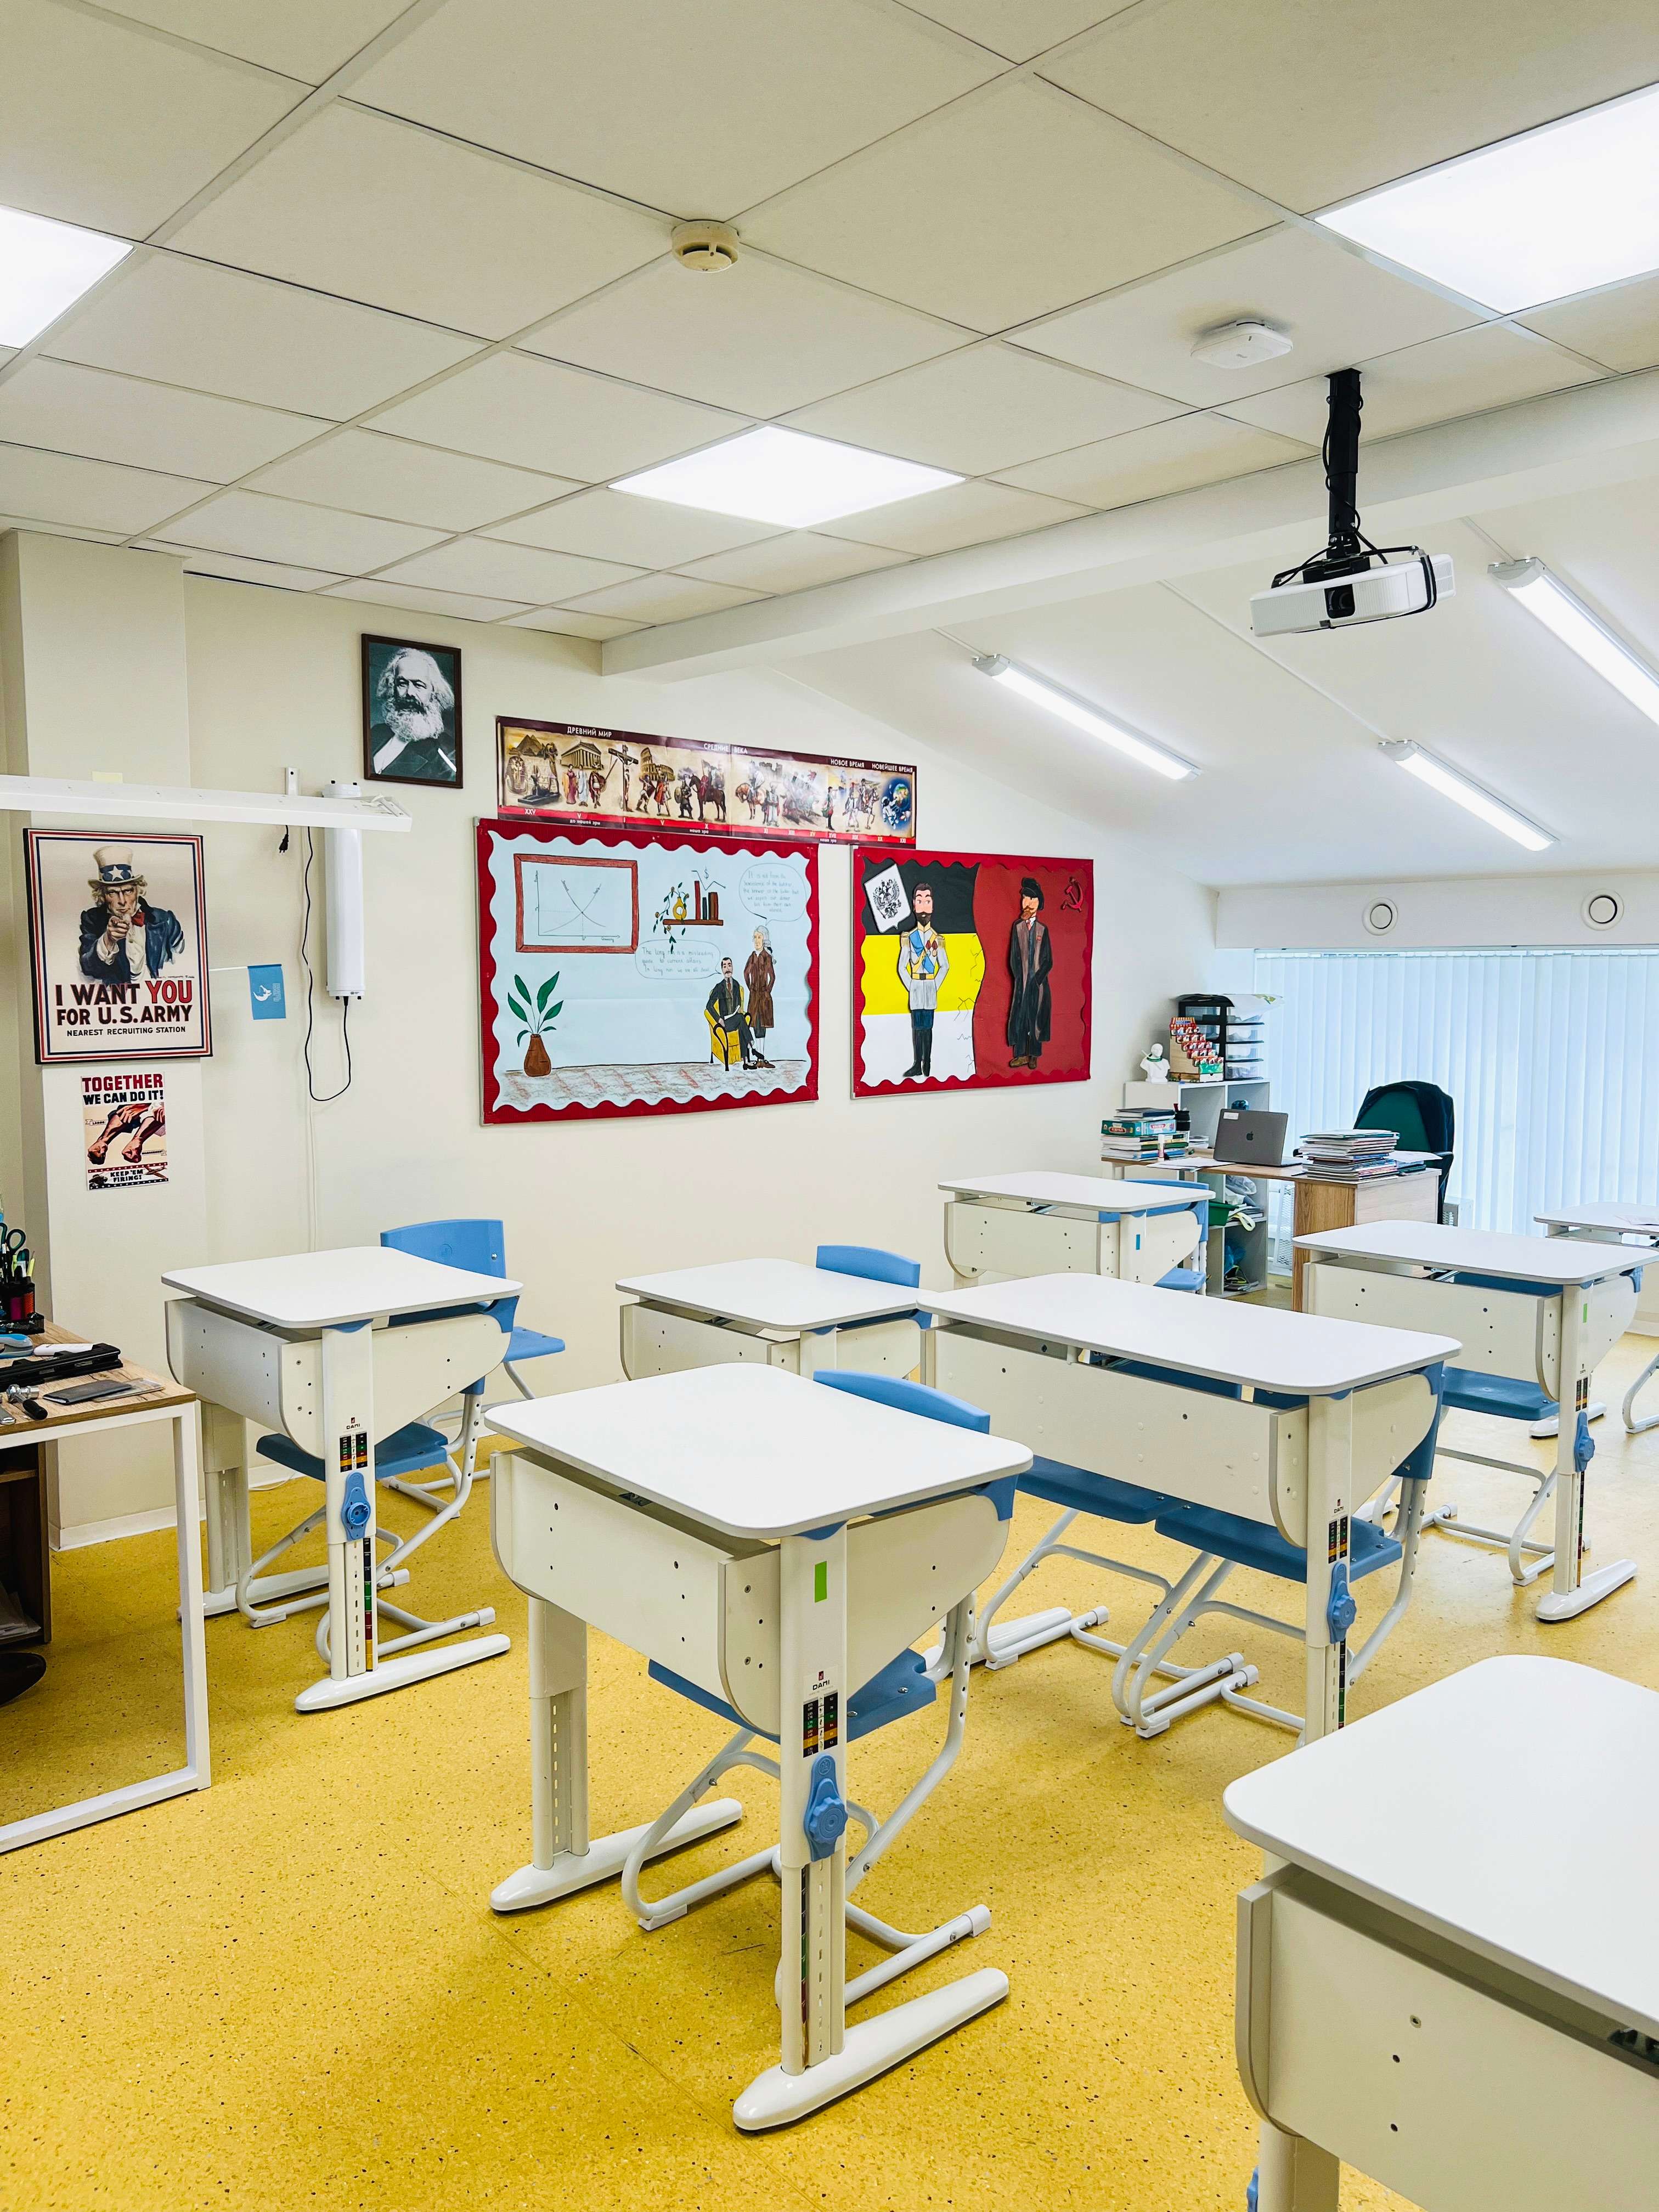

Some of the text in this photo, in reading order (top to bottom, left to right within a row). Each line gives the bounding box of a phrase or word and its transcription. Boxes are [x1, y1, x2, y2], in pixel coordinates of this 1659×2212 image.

[567, 726, 597, 736] ДРЕВНИЙ
[703, 743, 729, 752] СРЕДНИЕ
[872, 763, 898, 771] НОВЕЙШЕЕ
[642, 947, 652, 955] The
[55, 980, 193, 1006] I WANT YOU
[57, 1008, 91, 1026] FOR
[140, 1005, 193, 1023] ARMY
[108, 1027, 153, 1035] RECRUITING
[82, 1074, 163, 1093] TOGETHER
[83, 1090, 164, 1105] WE CAN DO IT!
[113, 1175, 142, 1183] FIRING!
[812, 1680, 830, 1690] DAMI
